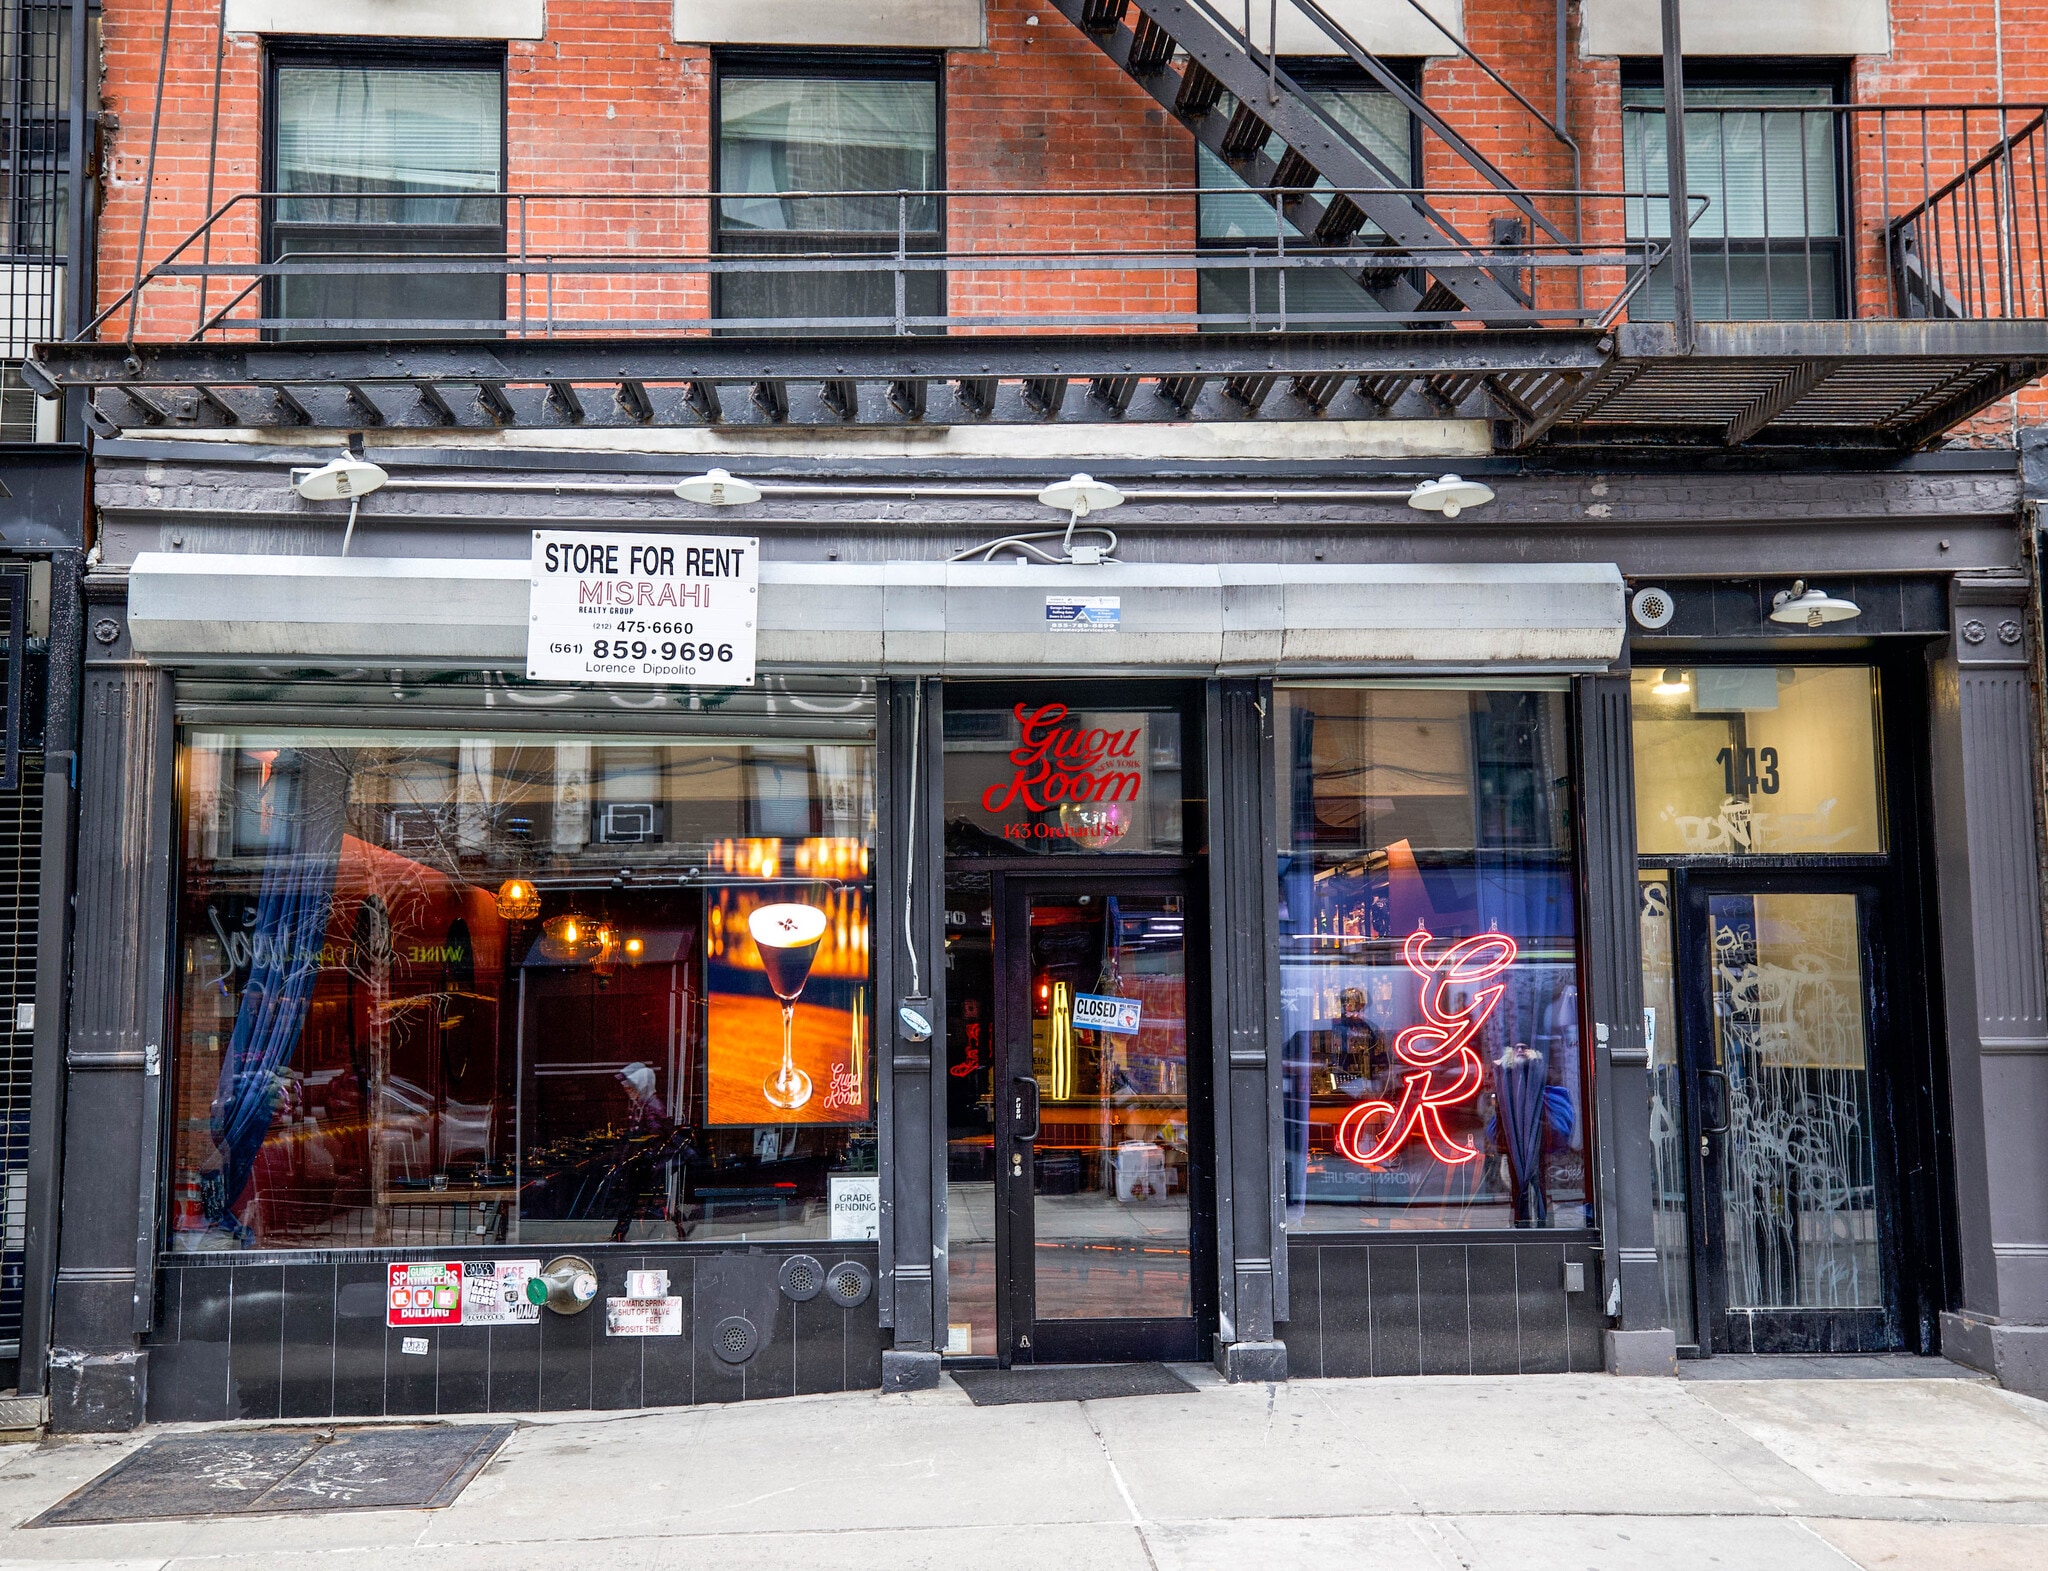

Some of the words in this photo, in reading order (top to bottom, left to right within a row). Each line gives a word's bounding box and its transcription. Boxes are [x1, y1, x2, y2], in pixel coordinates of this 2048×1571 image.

[545, 543, 618, 574] STORE
[630, 546, 674, 576] FOR
[686, 547, 744, 578] RENT
[578, 580, 710, 607] MISRAHI
[578, 606, 607, 614] REALTY
[609, 606, 634, 615] GROUP
[593, 622, 612, 630] (212)
[550, 642, 583, 654] (561)
[585, 661, 636, 674] Lorence
[643, 662, 696, 676] Dippolito
[1117, 759, 1141, 769] YORK
[1715, 747, 1780, 795] 143
[981, 757, 1141, 813] Room
[1003, 823, 1031, 839] 143
[1034, 822, 1101, 838] Orchard
[1104, 822, 1124, 837] St.
[1077, 999, 1117, 1018] CLOSED
[840, 1193, 872, 1202] GRADE
[834, 1202, 876, 1211] PENDING
[611, 1300, 644, 1308] AUTOMATIC
[401, 1308, 450, 1319] BUILDING
[517, 1304, 539, 1319] DAUB
[618, 1308, 635, 1316] SHUT
[637, 1308, 649, 1316] OFF
[650, 1308, 670, 1316] VALVE
[646, 1316, 661, 1324] FEET
[645, 1325, 659, 1333] THIS
